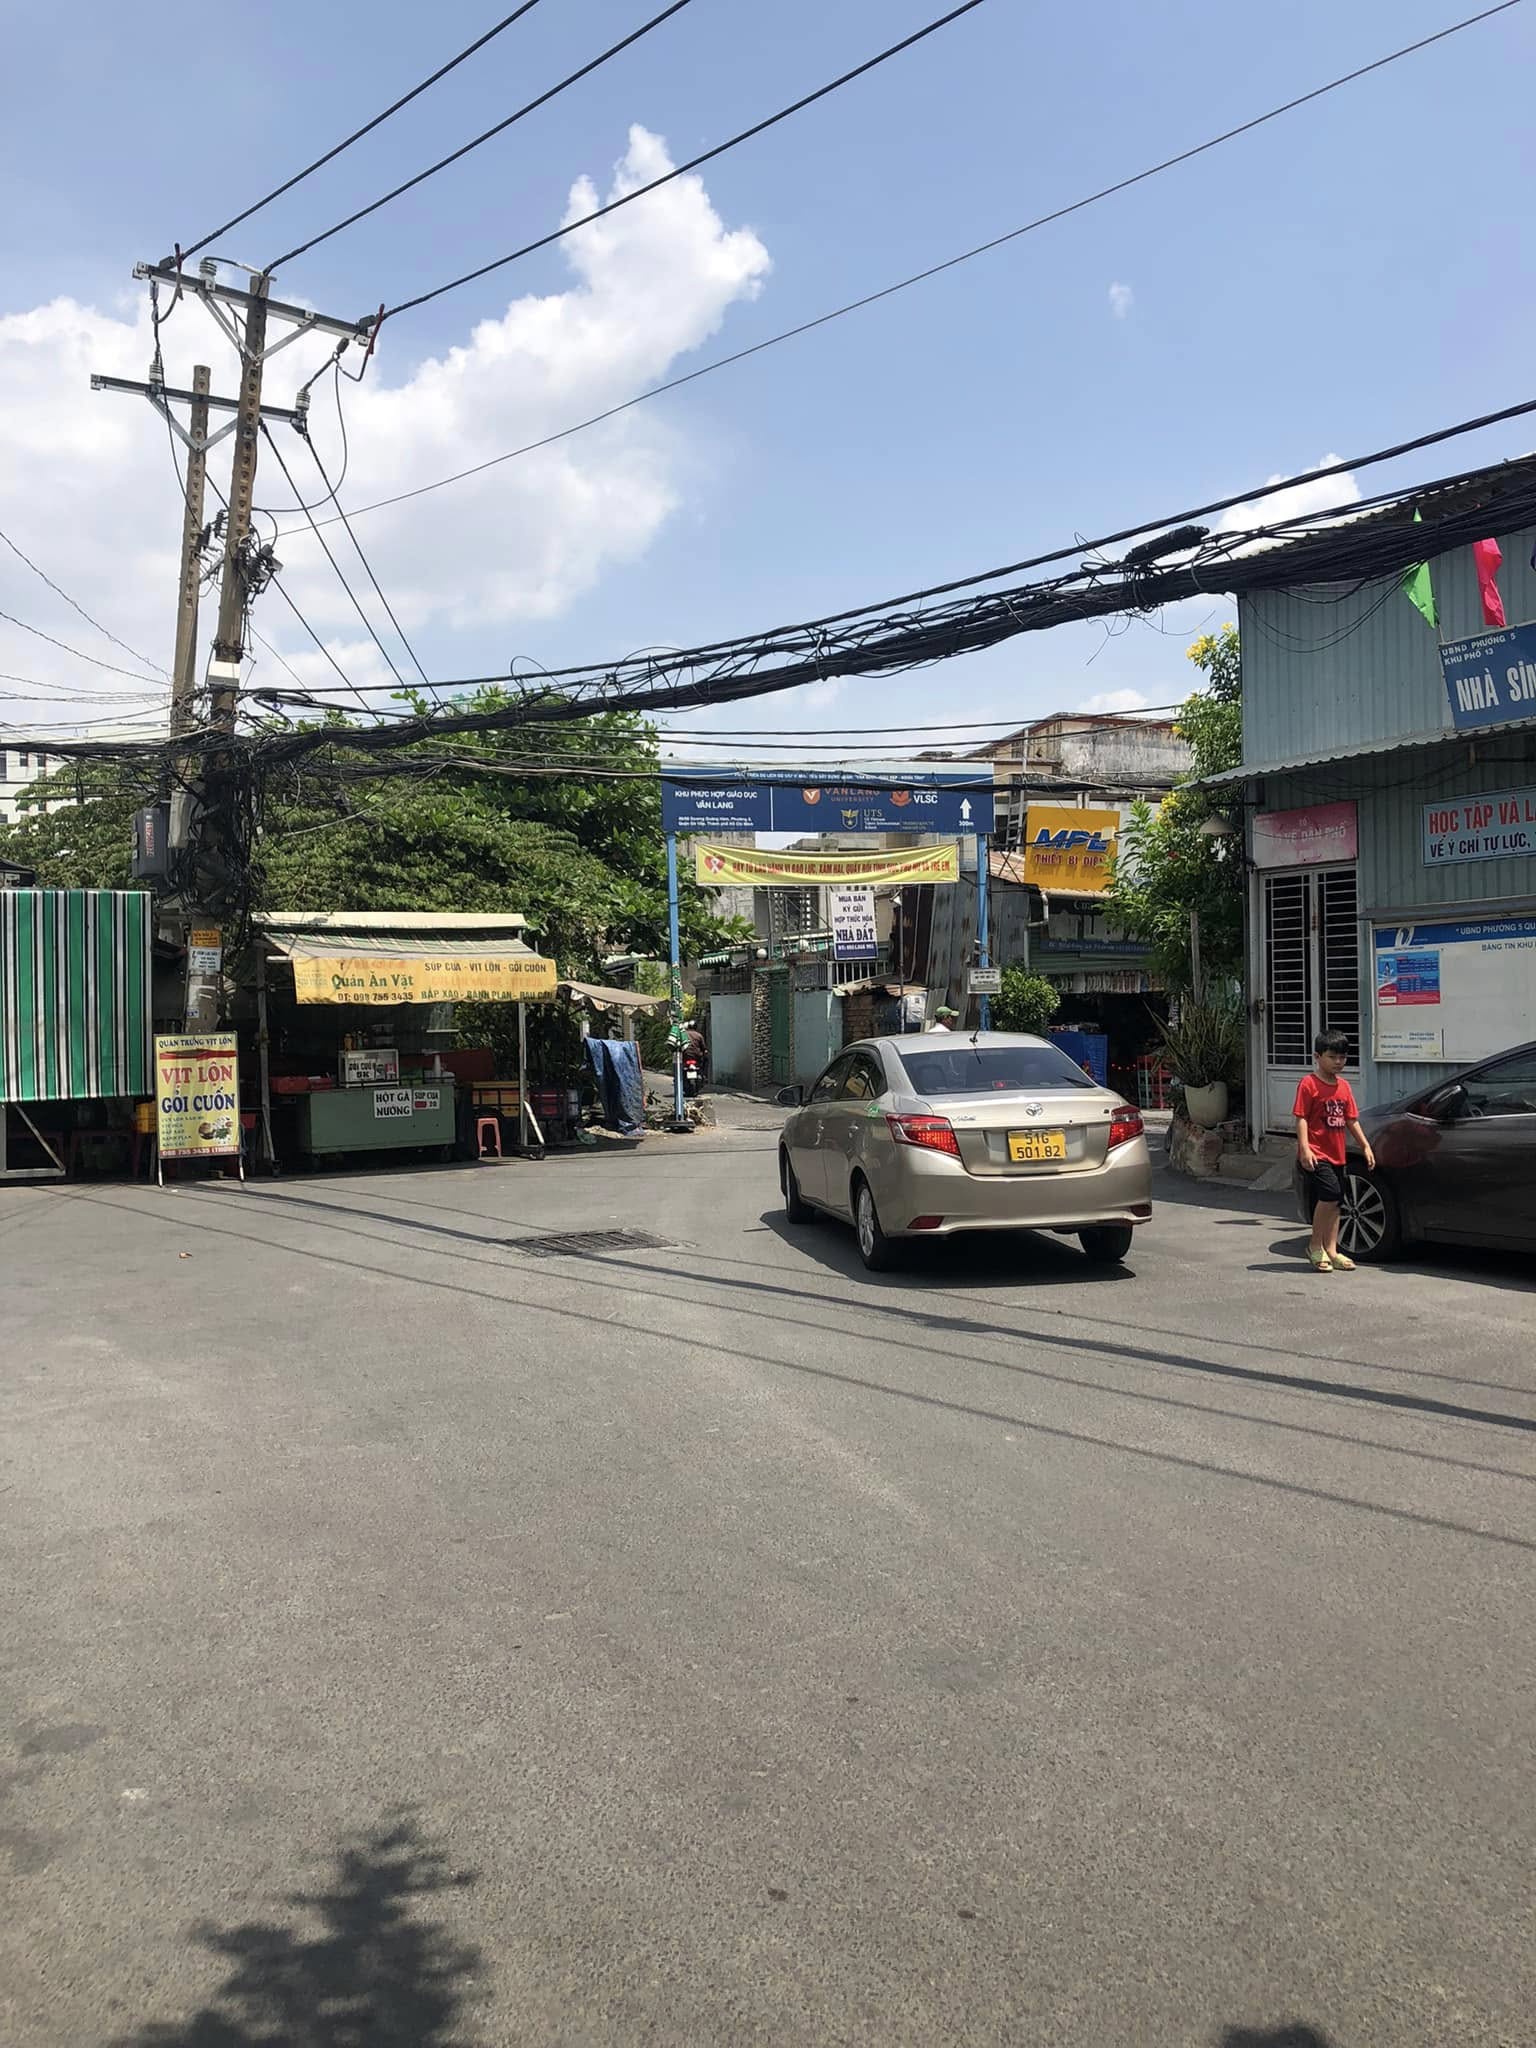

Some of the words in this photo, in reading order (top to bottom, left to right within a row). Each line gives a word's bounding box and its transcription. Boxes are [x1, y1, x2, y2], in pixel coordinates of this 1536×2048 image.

[1442, 644, 1467, 656] UBND
[1444, 655, 1462, 665] KHU
[1456, 667, 1499, 712] NHÀ
[675, 790, 690, 798] KHU
[913, 795, 938, 804] VLSC
[713, 801, 734, 809] LANG
[864, 809, 883, 817] UTS
[1429, 809, 1459, 838] HỌC
[1464, 801, 1494, 833] TẬP
[1499, 795, 1520, 824] VÀ
[1525, 799, 1536, 822] L
[1483, 835, 1499, 854] TỰ
[1034, 851, 1062, 865] THIẾT
[836, 925, 854, 941] NHÀ
[856, 922, 874, 941] ĐẤT
[1518, 923, 1523, 931] 5
[1504, 942, 1516, 950] TIN
[1517, 941, 1533, 949] KHU
[469, 963, 482, 973] VỊT
[331, 973, 364, 989] Quán
[369, 971, 387, 987] Ăn
[391, 974, 414, 990] Vặt
[391, 992, 414, 1001] 3435
[207, 1038, 217, 1047] VỊT
[161, 1067, 192, 1088] VỊT
[198, 1061, 233, 1086] LỘN
[161, 1089, 189, 1113] GỎI
[193, 1087, 235, 1112] CUỐN
[376, 1091, 395, 1104] HỘT
[397, 1091, 410, 1101] GÀ
[1025, 1133, 1050, 1146] 51G
[1016, 1145, 1061, 1160] 501.82
